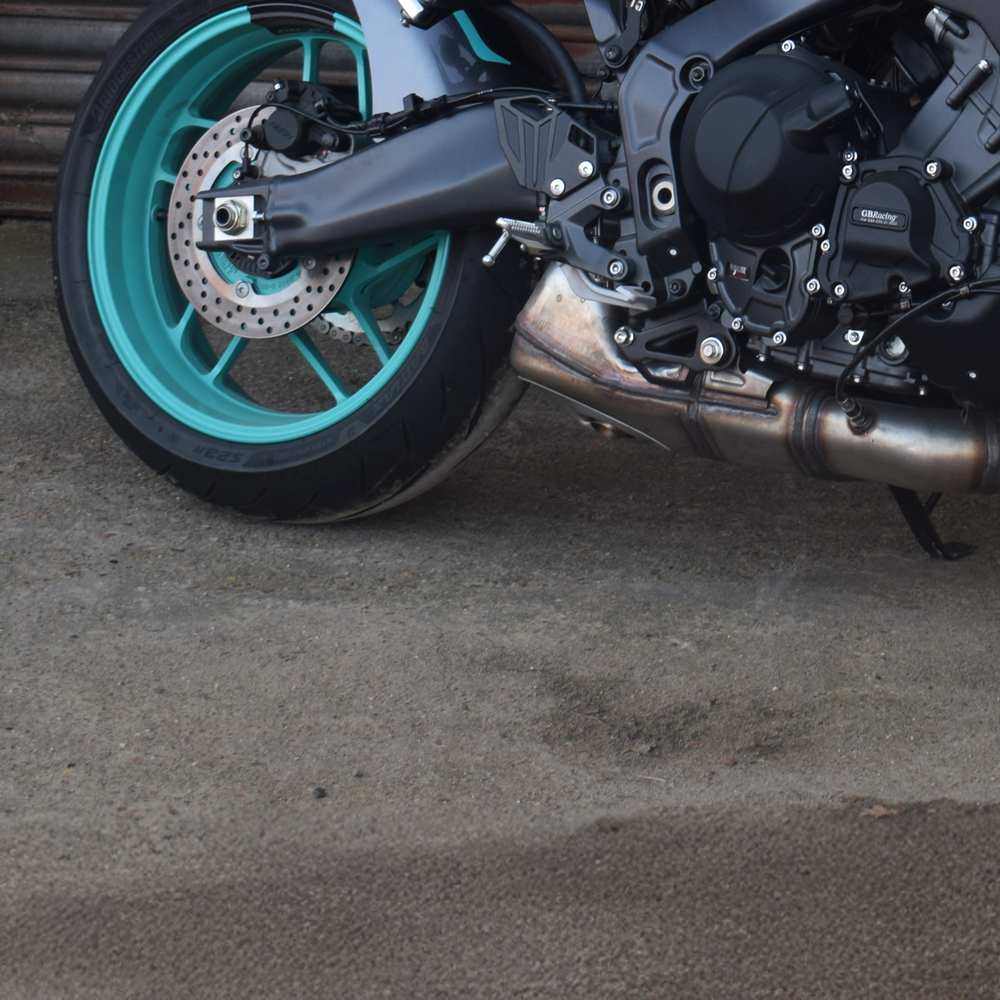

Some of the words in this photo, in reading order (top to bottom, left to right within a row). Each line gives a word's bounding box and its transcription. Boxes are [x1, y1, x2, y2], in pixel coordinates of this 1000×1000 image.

[90, 24, 165, 122] BRIDGESTONE
[861, 209, 897, 221] GBRacing
[192, 444, 246, 463] S23R
